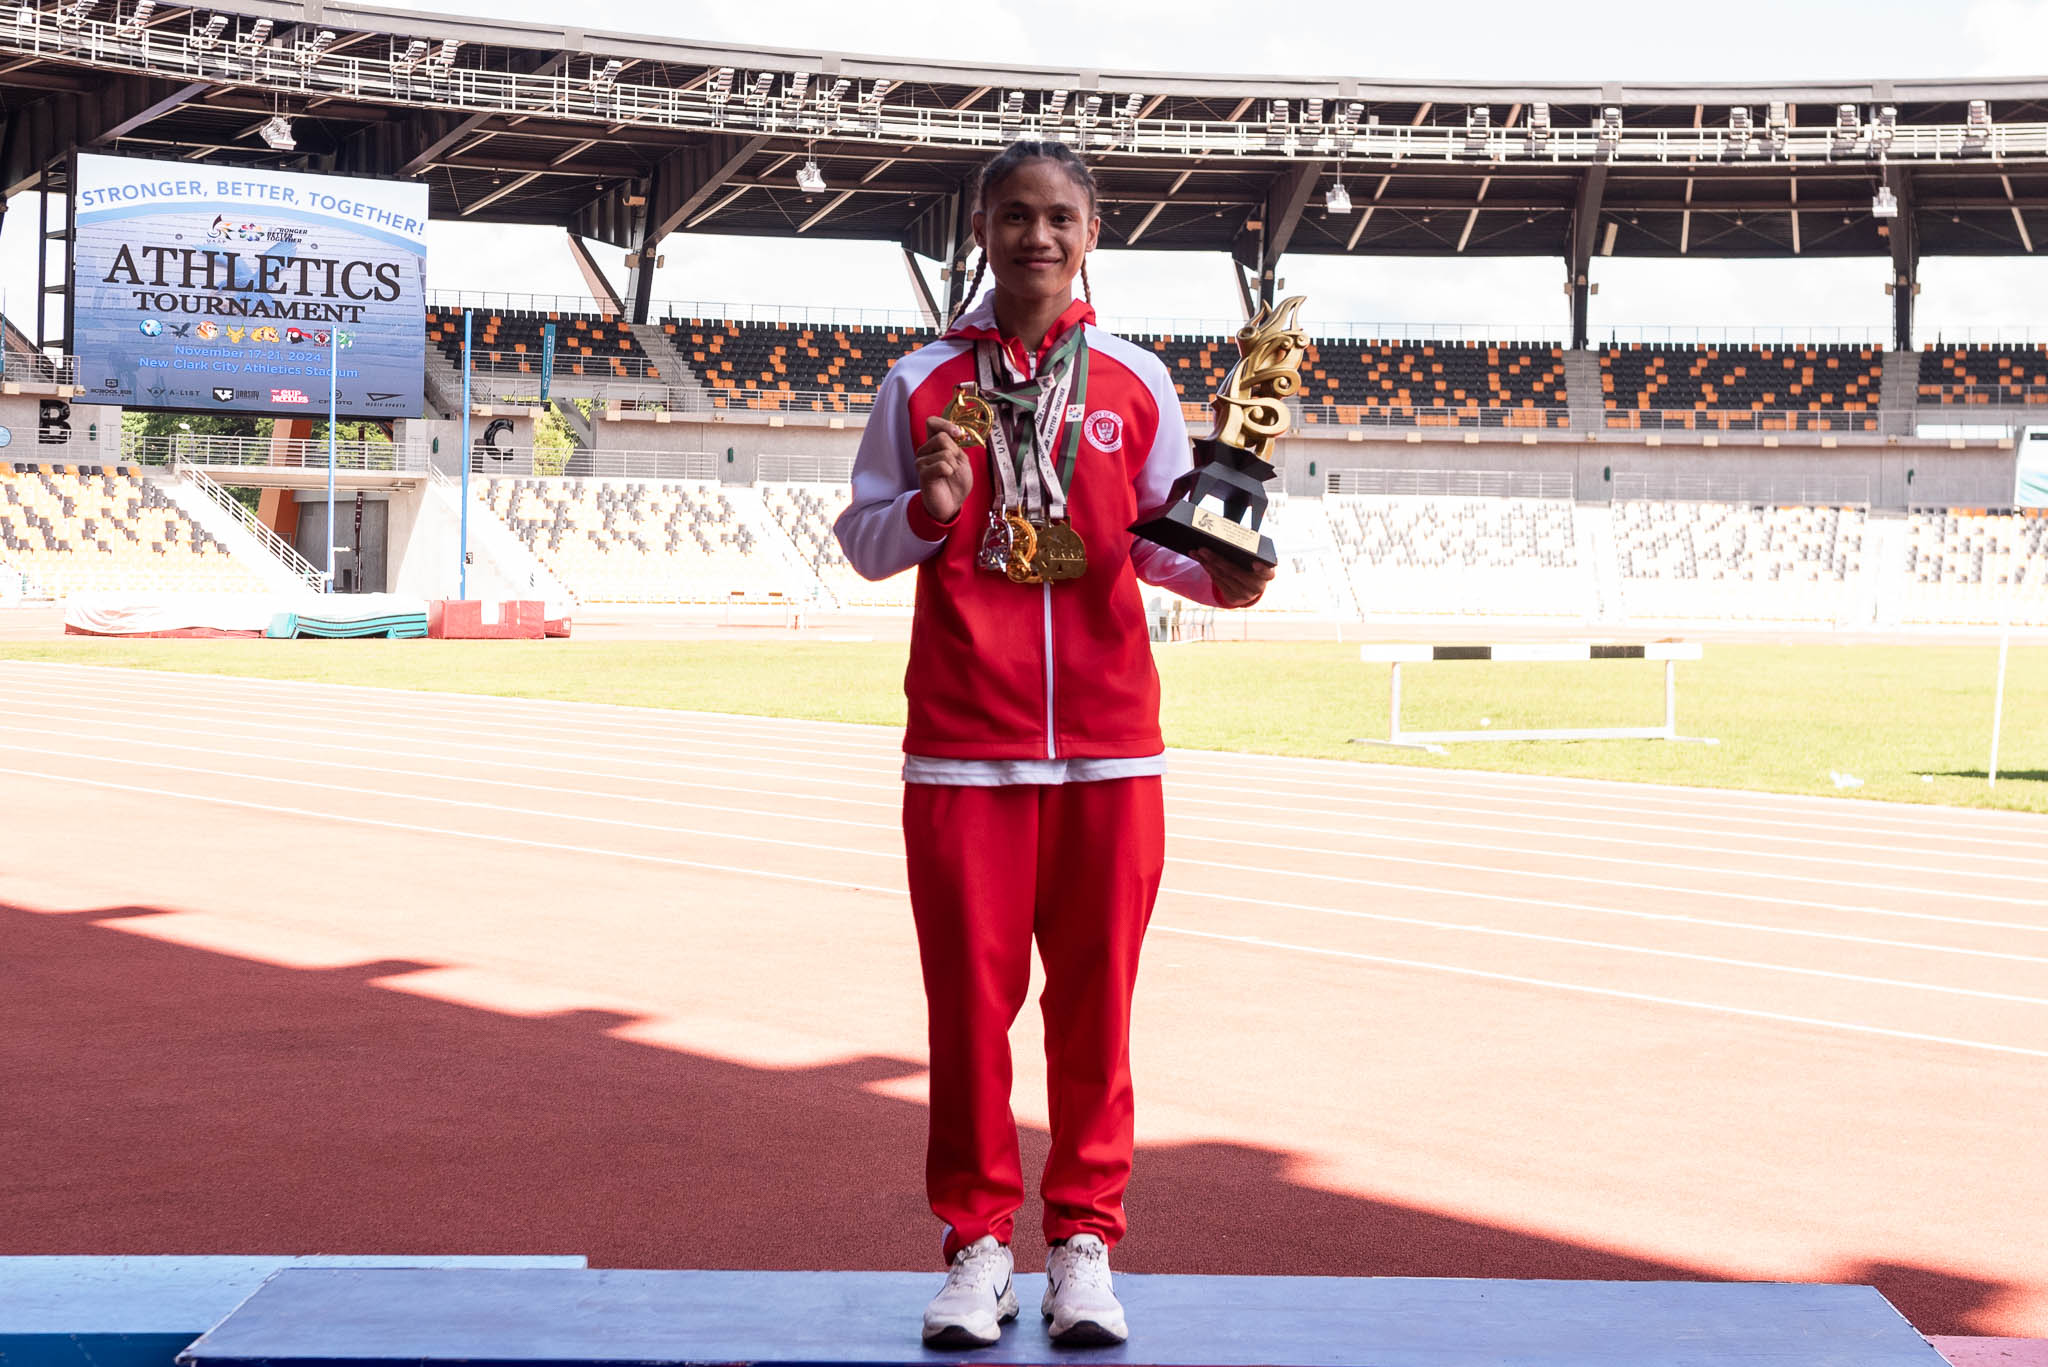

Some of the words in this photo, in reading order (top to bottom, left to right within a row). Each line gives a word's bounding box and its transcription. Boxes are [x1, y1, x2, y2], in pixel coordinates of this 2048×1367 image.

[82, 180, 208, 207] STRONGER,
[217, 180, 299, 206] BETTER,
[309, 191, 425, 236] TOGETHER!
[102, 243, 400, 301] ATHLETICS
[133, 290, 365, 323] TOURNAMENT
[139, 357, 169, 368] New
[173, 358, 208, 370] Clark
[212, 360, 240, 374] City
[243, 361, 301, 375] Athletics
[175, 345, 244, 358] November
[249, 350, 284, 362] 17-21,
[288, 352, 322, 362] 2024
[39, 399, 72, 444] B
[484, 418, 514, 461] C
